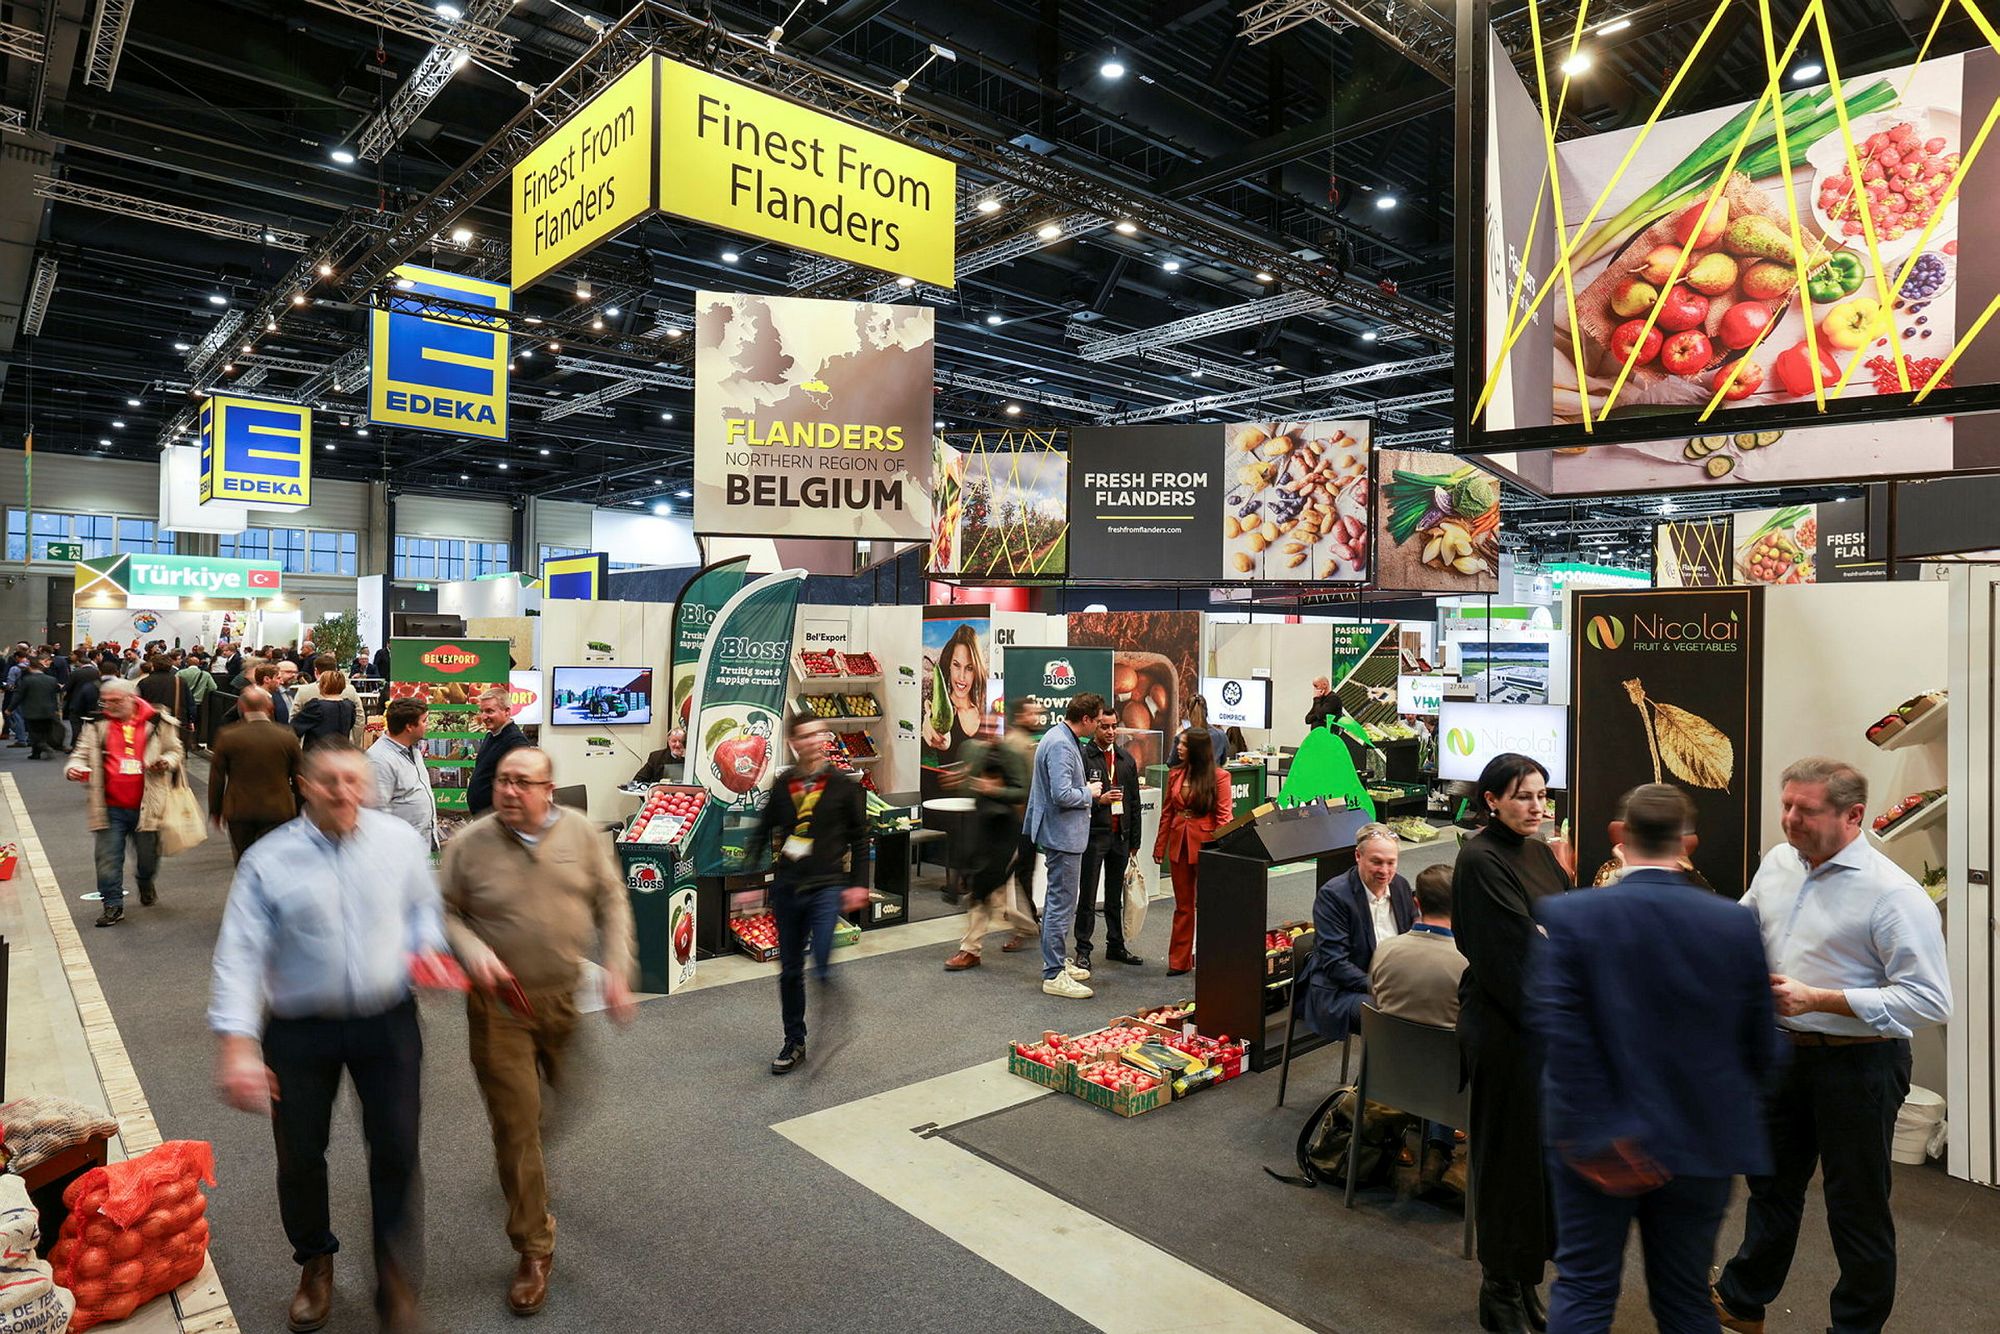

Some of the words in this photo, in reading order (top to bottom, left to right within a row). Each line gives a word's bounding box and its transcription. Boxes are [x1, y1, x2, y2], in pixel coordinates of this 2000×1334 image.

[522, 148, 576, 214] Finest
[580, 104, 635, 173] From
[697, 93, 825, 178] Finest
[838, 143, 931, 212] From
[534, 175, 616, 257] Flanders
[730, 163, 901, 253] Flanders
[386, 390, 497, 425] EDEKA
[725, 418, 905, 452] FLANDERS
[725, 452, 813, 469] NORTHERN
[819, 455, 878, 472] REGION
[884, 458, 905, 471] OF
[223, 477, 302, 497] EDEKA
[1084, 472, 1145, 488] FRESH
[1151, 472, 1208, 488] FROM
[726, 473, 903, 511] BELGIUM
[1095, 490, 1197, 506] FLANDERS
[1107, 525, 1182, 534] freshfromflanders.com
[131, 563, 241, 590] Türkiye
[1843, 568, 1898, 578] freshfromflanders.
[681, 603, 718, 625] Blo
[805, 633, 847, 643] Bel'Export
[1335, 626, 1372, 635] PASSION
[720, 637, 785, 660] Bloss
[1335, 636, 1353, 645] FOR
[1633, 642, 1660, 652] FRUIT
[1662, 642, 1671, 651] &
[1674, 642, 1738, 652] VEGETABLES
[424, 653, 477, 665] BEL'EXPORT
[1335, 647, 1360, 655] FRUIT
[720, 666, 753, 677] Fruitig
[754, 668, 773, 677] zoet
[716, 675, 750, 686] sappige
[1043, 674, 1076, 687] Bloss
[509, 691, 533, 704] ORT
[628, 876, 664, 890] Bloss
[12, 1301, 35, 1319] DE
